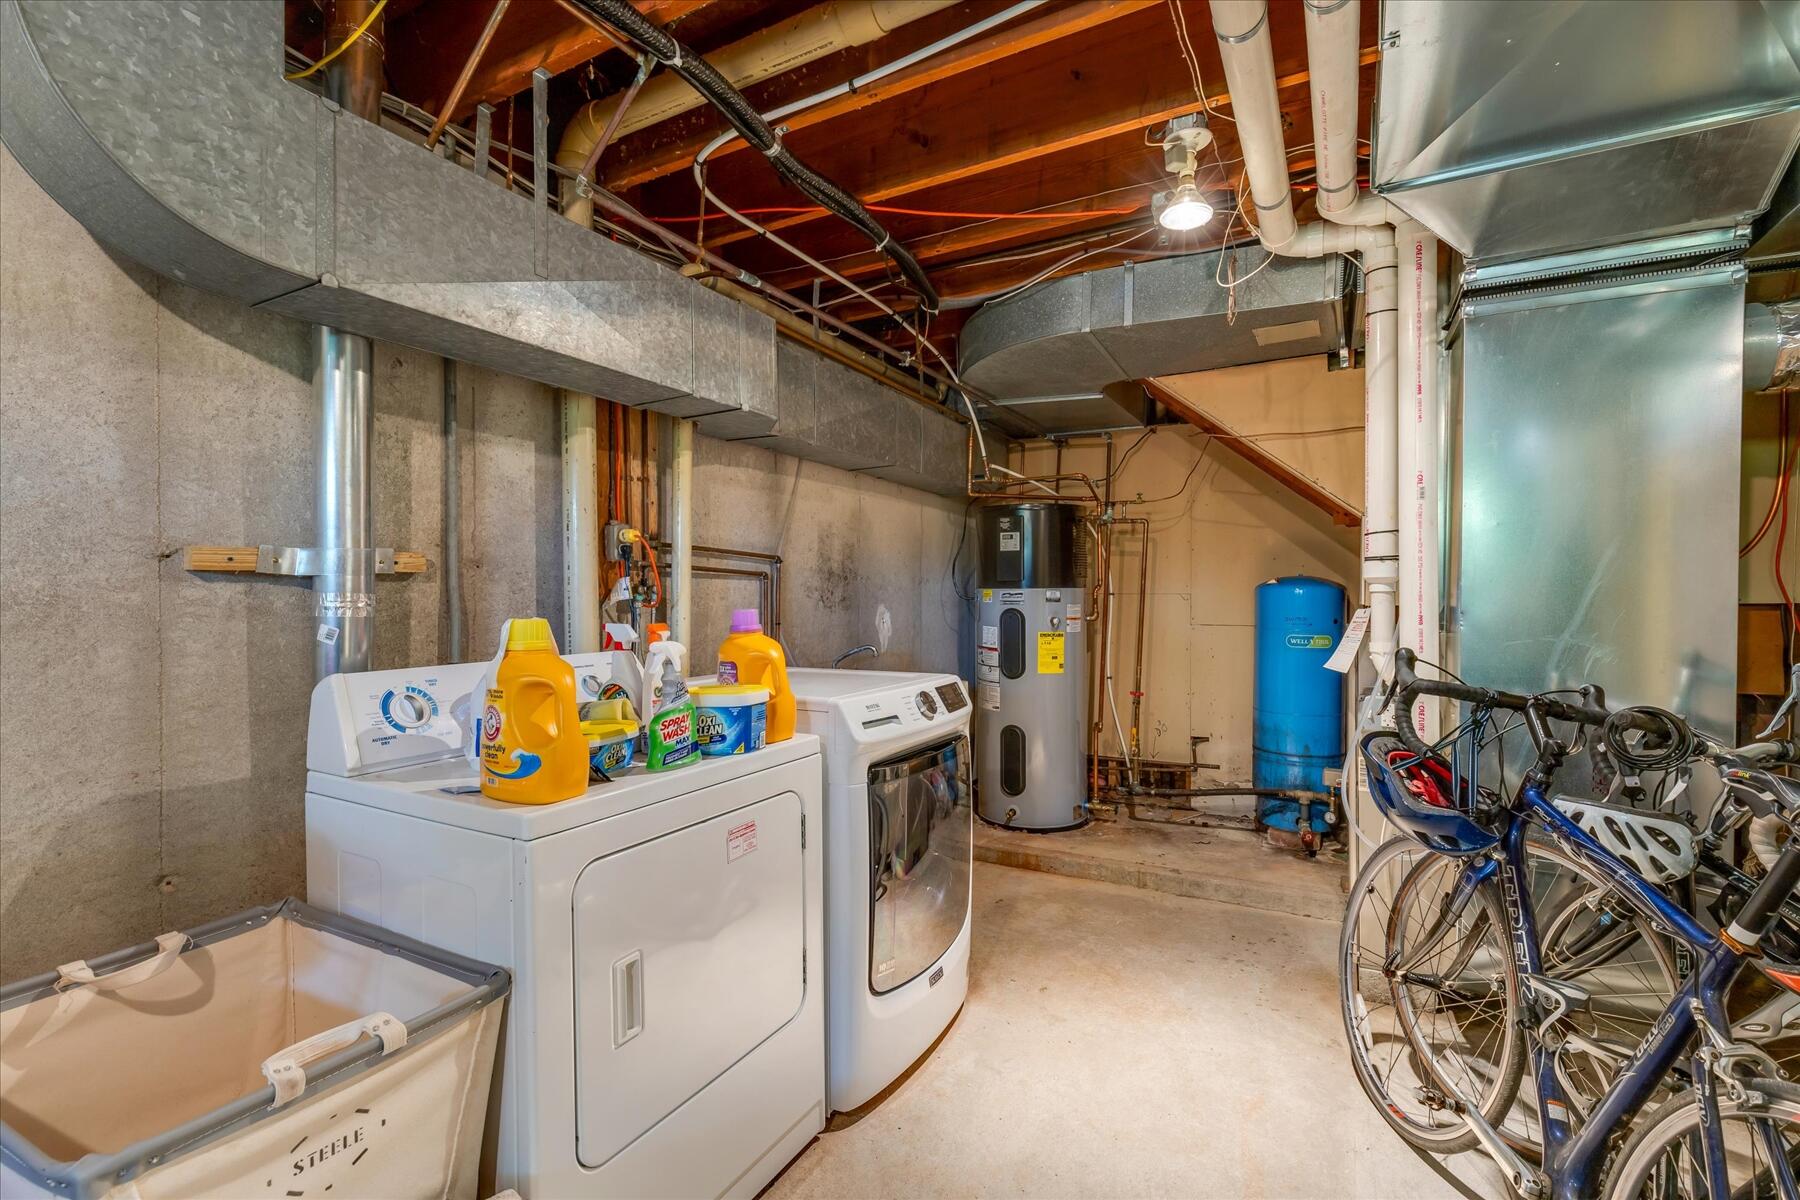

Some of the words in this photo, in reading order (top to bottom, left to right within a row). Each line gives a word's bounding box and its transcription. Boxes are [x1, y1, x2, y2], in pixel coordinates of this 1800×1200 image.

[660, 711, 691, 732] SPRAY
[698, 714, 717, 728] OXI
[662, 725, 690, 743] WASH
[605, 747, 627, 763] CLEAN
[1504, 865, 1536, 1006] TREK
[292, 1127, 364, 1177] STEELE
